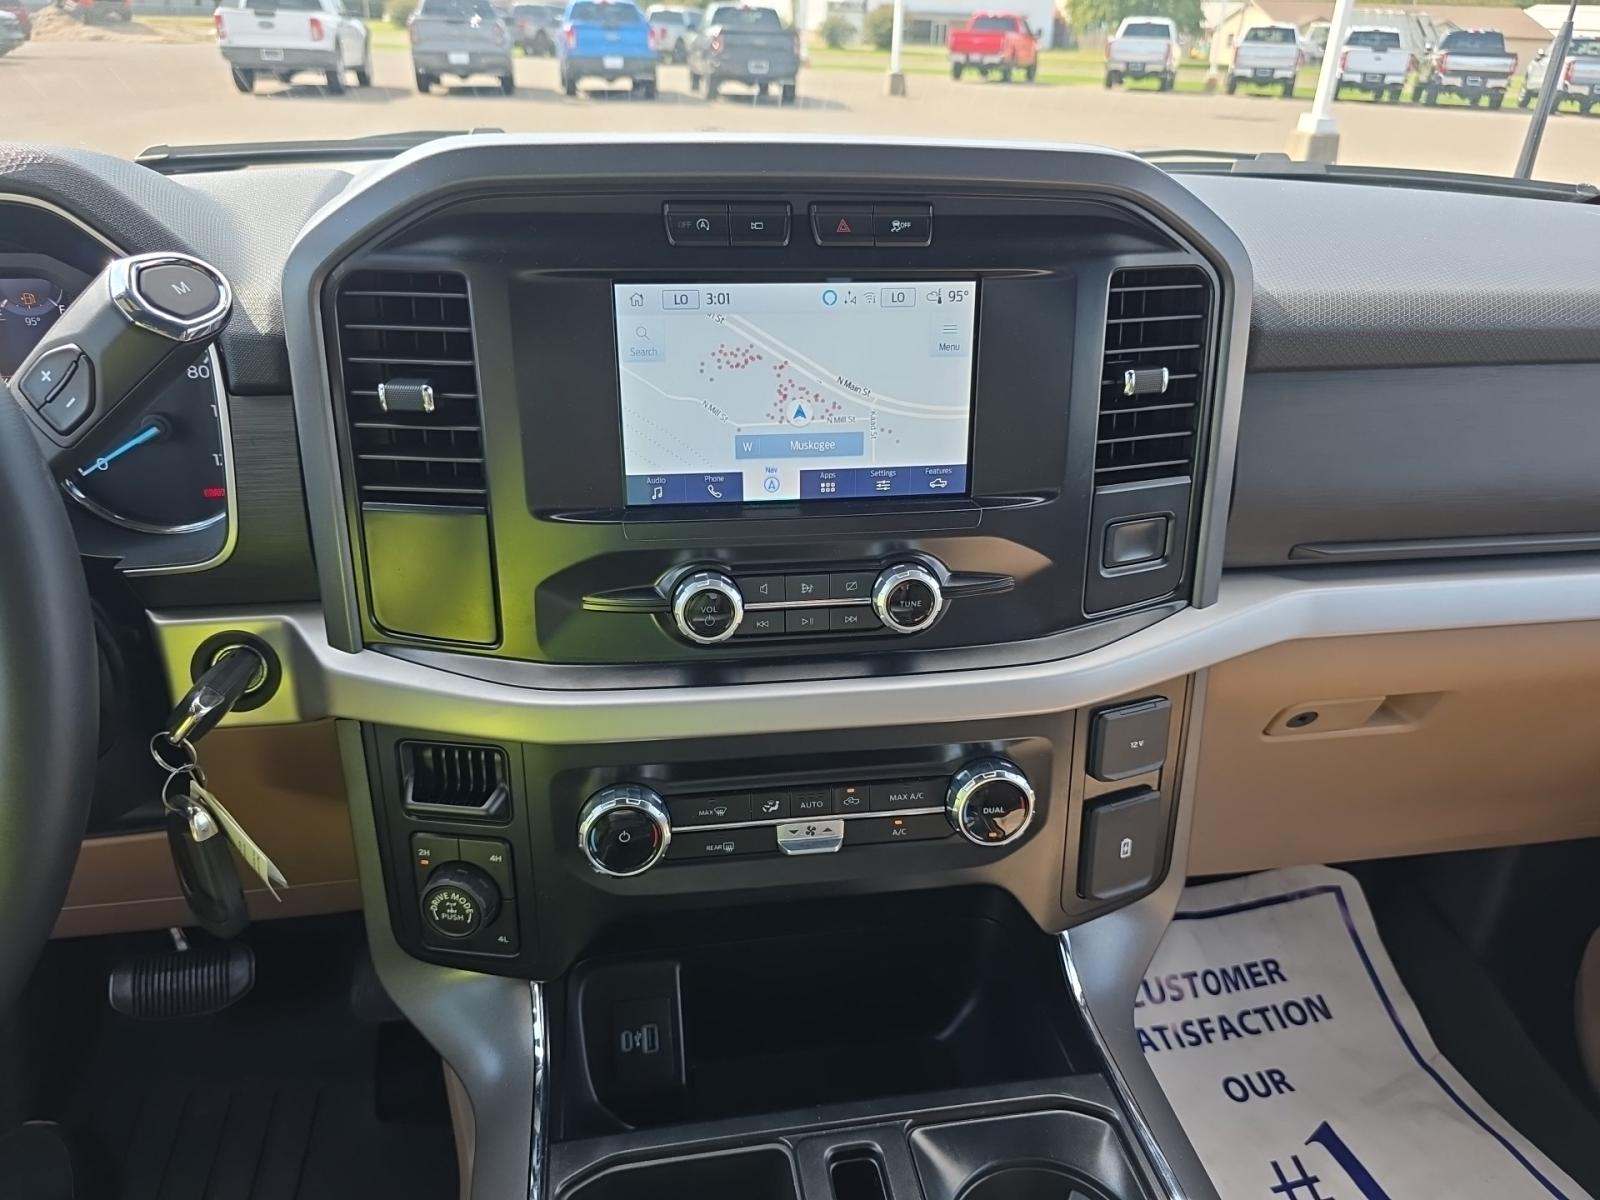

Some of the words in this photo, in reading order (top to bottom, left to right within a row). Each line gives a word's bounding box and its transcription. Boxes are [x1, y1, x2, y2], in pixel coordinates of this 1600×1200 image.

[172, 282, 191, 294] M
[674, 294, 689, 305] LO
[706, 292, 730, 305] 3:01
[891, 292, 905, 303] LO
[630, 347, 658, 357] Search
[939, 343, 960, 352] Menu
[187, 365, 210, 378] 80
[844, 380, 861, 394] Main
[862, 387, 871, 397] St
[708, 404, 721, 417] Mill
[720, 413, 729, 423] St
[743, 441, 753, 452] W
[790, 440, 836, 451] Muskogee
[766, 466, 777, 474] Nav
[870, 470, 897, 478] Settings
[925, 467, 953, 475] Features
[646, 476, 667, 484] Audio
[704, 475, 724, 483] Phone
[820, 471, 836, 480] Apps
[900, 600, 922, 608] TUNE
[701, 605, 718, 614] VOL
[889, 794, 907, 802] MAX
[909, 792, 925, 800] A/C
[800, 801, 824, 809] AUTO
[983, 806, 1005, 815] DUAL
[892, 828, 907, 836] A/C
[418, 848, 430, 856] 2H
[430, 892, 449, 911] DRIVE
[451, 893, 474, 914] MODE
[441, 913, 464, 921] PUSH
[1136, 993, 1333, 1053] ATISFACTION
[1221, 1068, 1297, 1103] OUR
